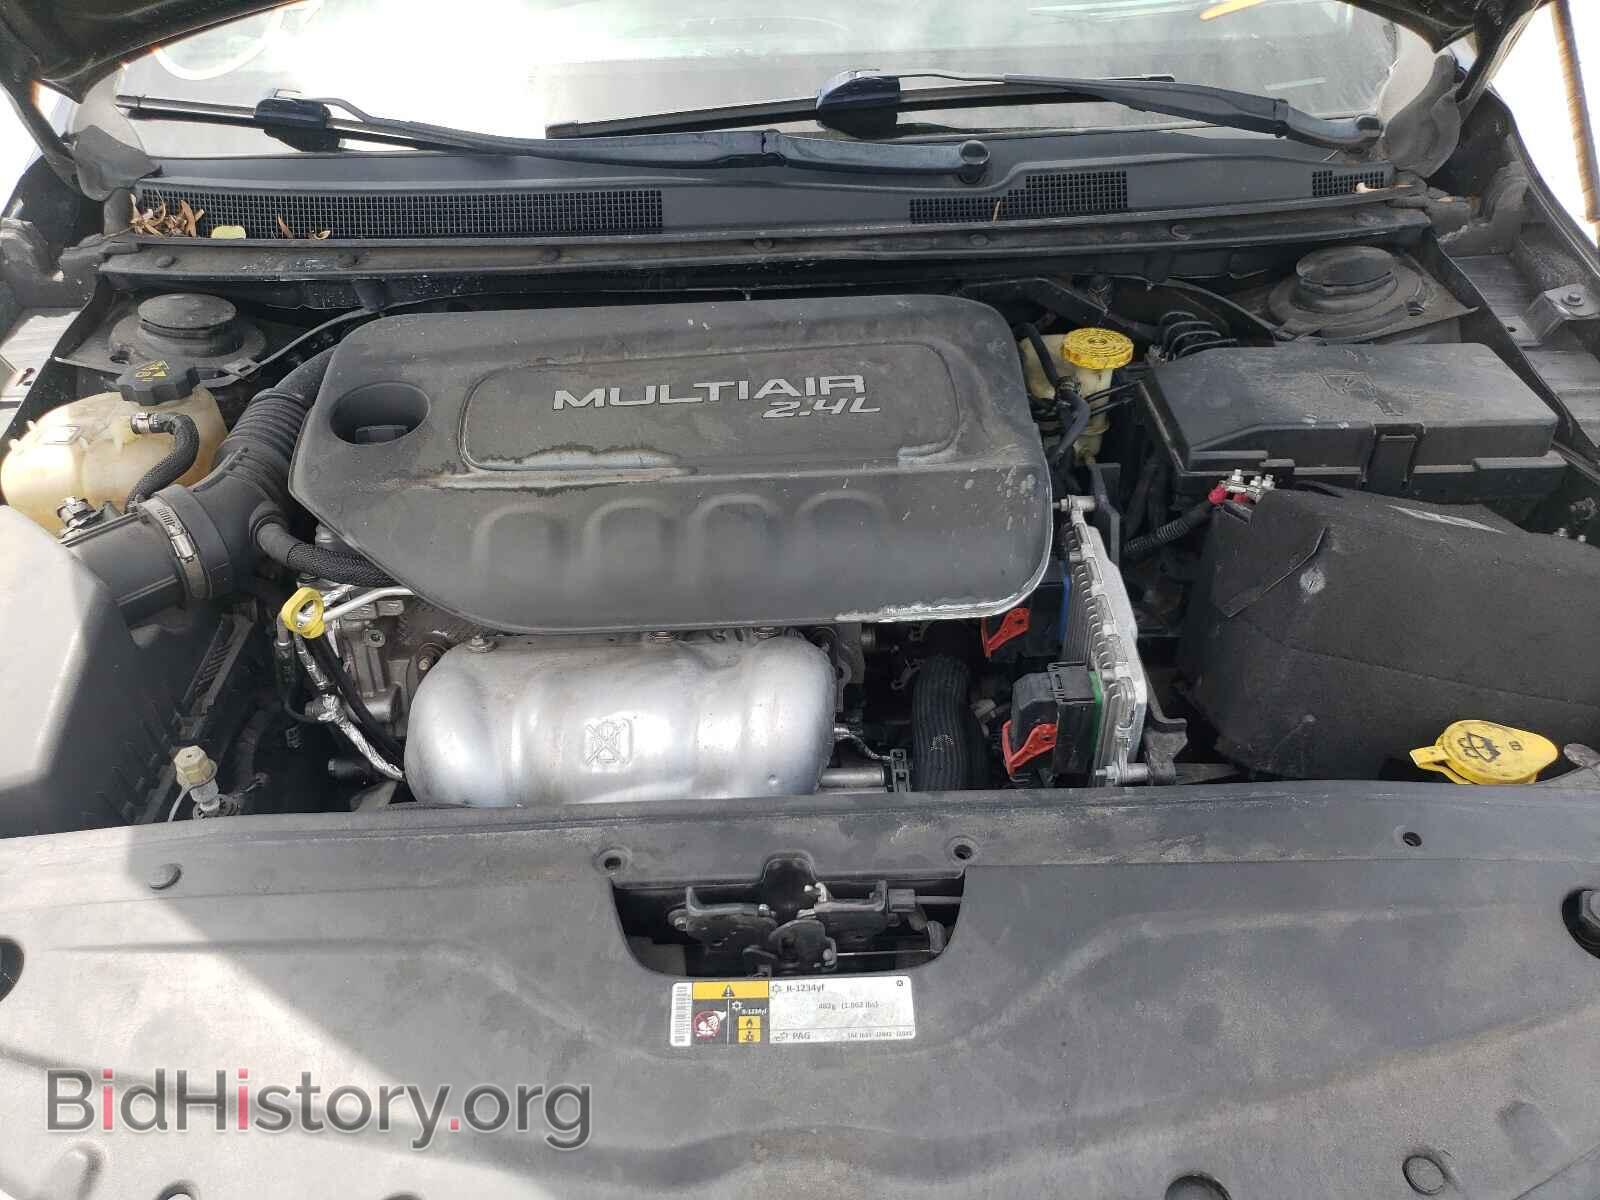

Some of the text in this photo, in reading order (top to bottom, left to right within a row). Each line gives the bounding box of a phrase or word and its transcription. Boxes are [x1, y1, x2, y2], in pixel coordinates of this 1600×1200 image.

[552, 374, 866, 411] MULTIAIR
[761, 397, 881, 419] 2.4L
[786, 983, 825, 993] R-1234yf
[792, 1031, 811, 1040] PAG
